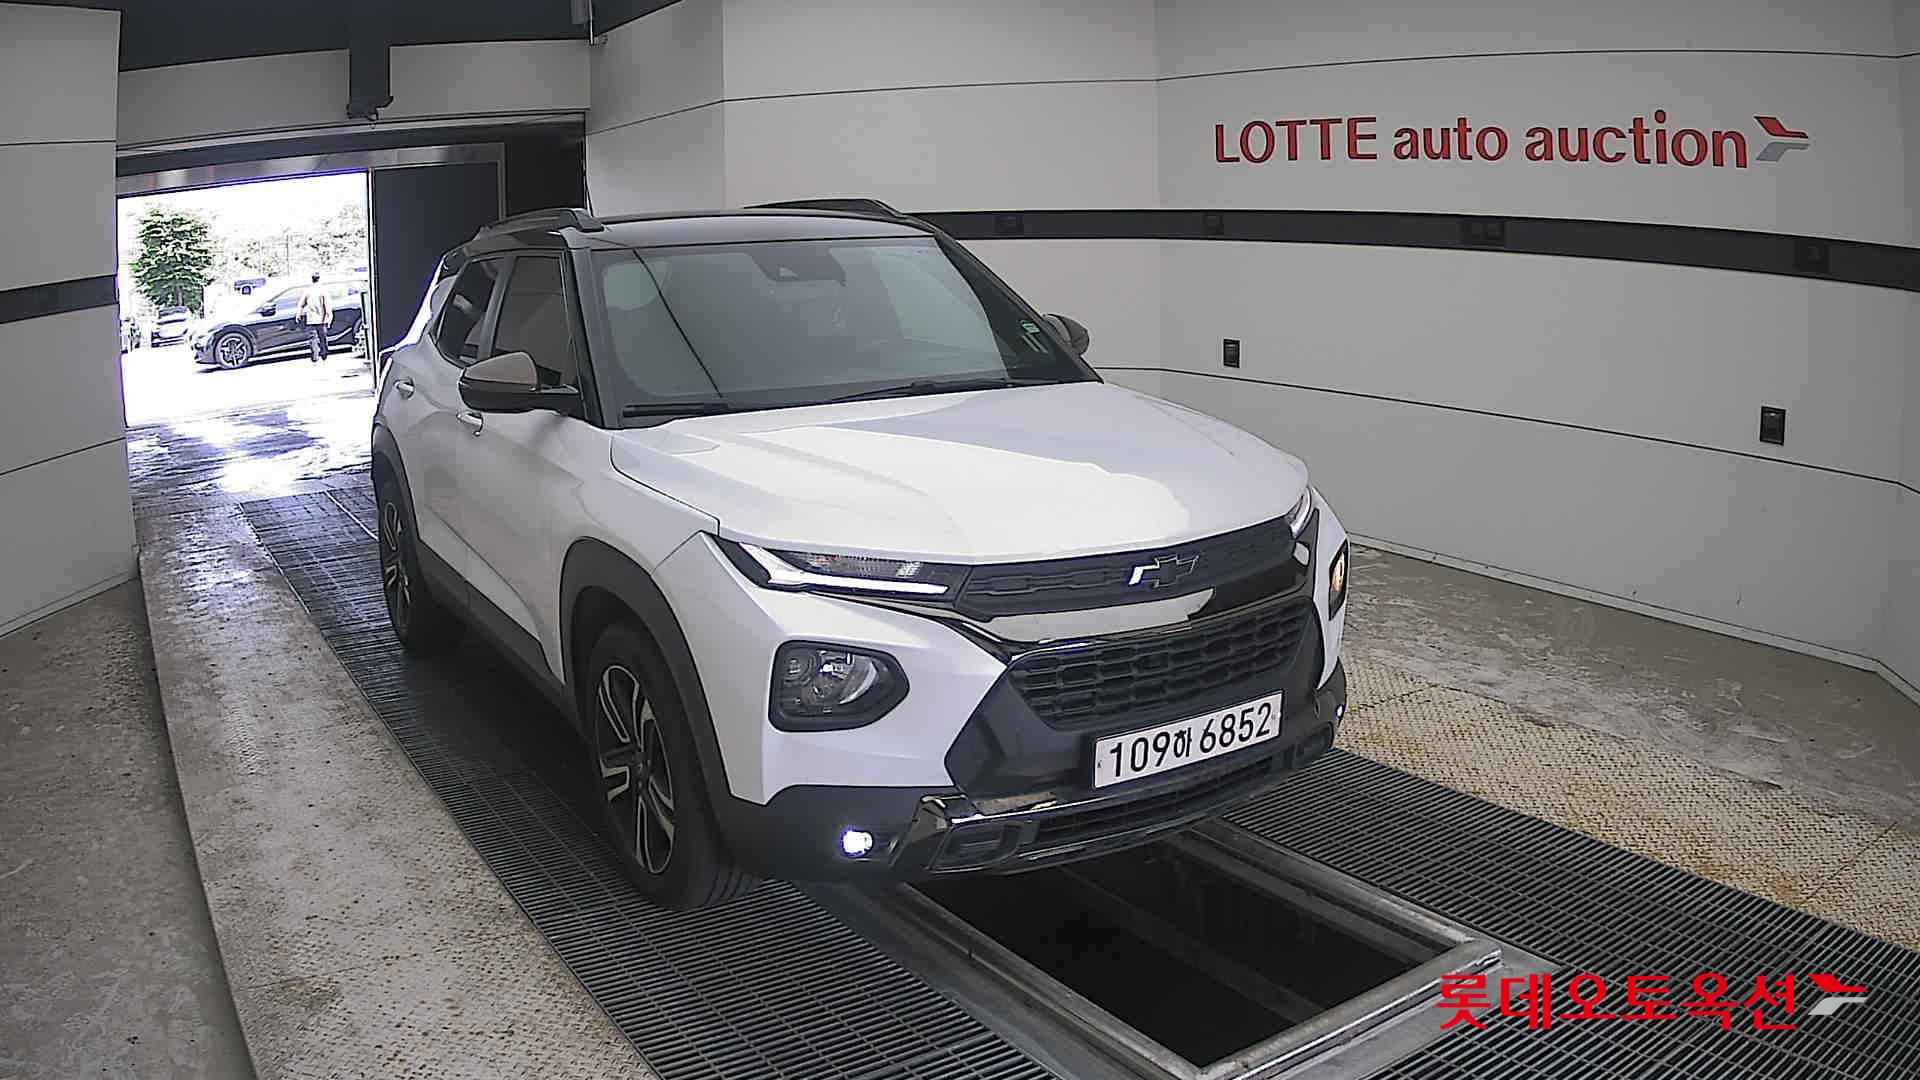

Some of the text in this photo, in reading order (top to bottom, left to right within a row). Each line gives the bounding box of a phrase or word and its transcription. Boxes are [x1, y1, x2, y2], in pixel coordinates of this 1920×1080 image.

[1215, 109, 1748, 168] LOTTE auto auction
[1110, 702, 1272, 777] 109하 6852
